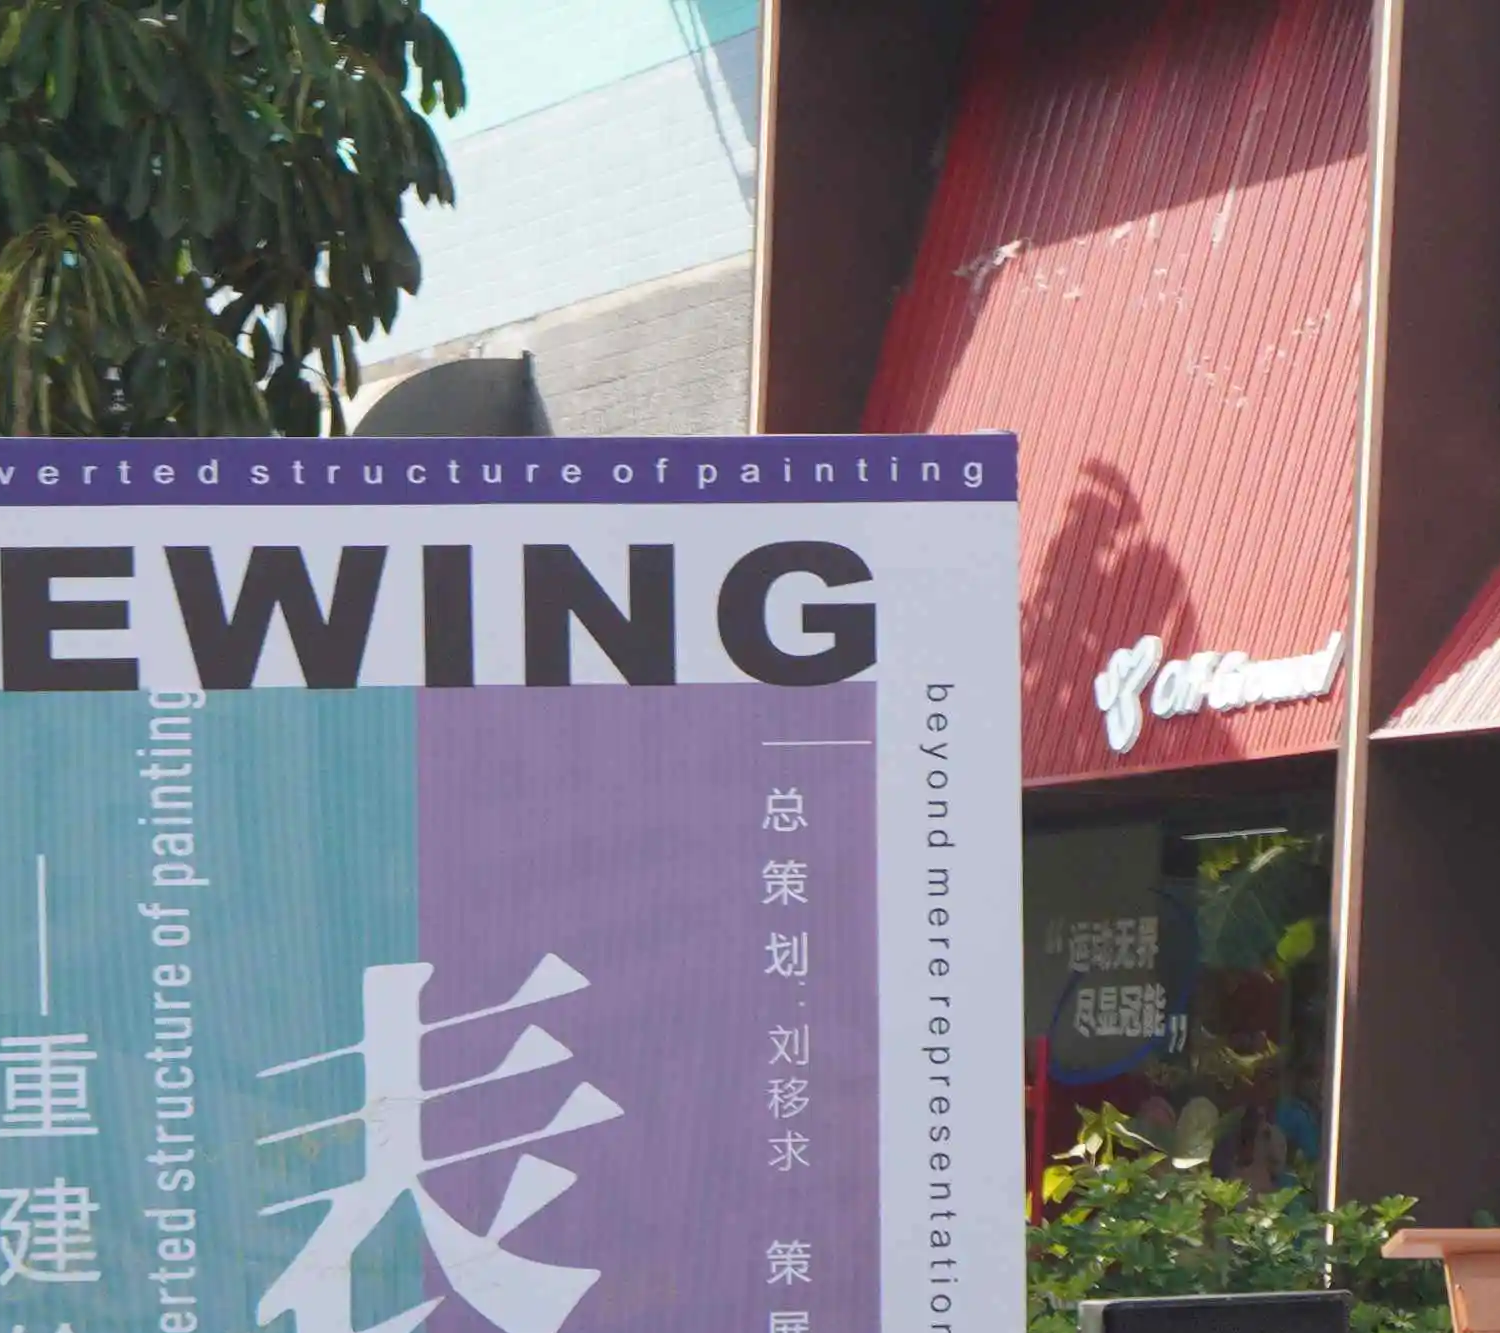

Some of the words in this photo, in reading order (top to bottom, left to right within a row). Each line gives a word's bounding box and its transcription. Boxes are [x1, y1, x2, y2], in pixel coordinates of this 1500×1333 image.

[136, 686, 209, 886] painting
[918, 682, 956, 849] beyond
[138, 902, 191, 948] of
[926, 867, 952, 979] mere
[144, 963, 196, 1191] structure
